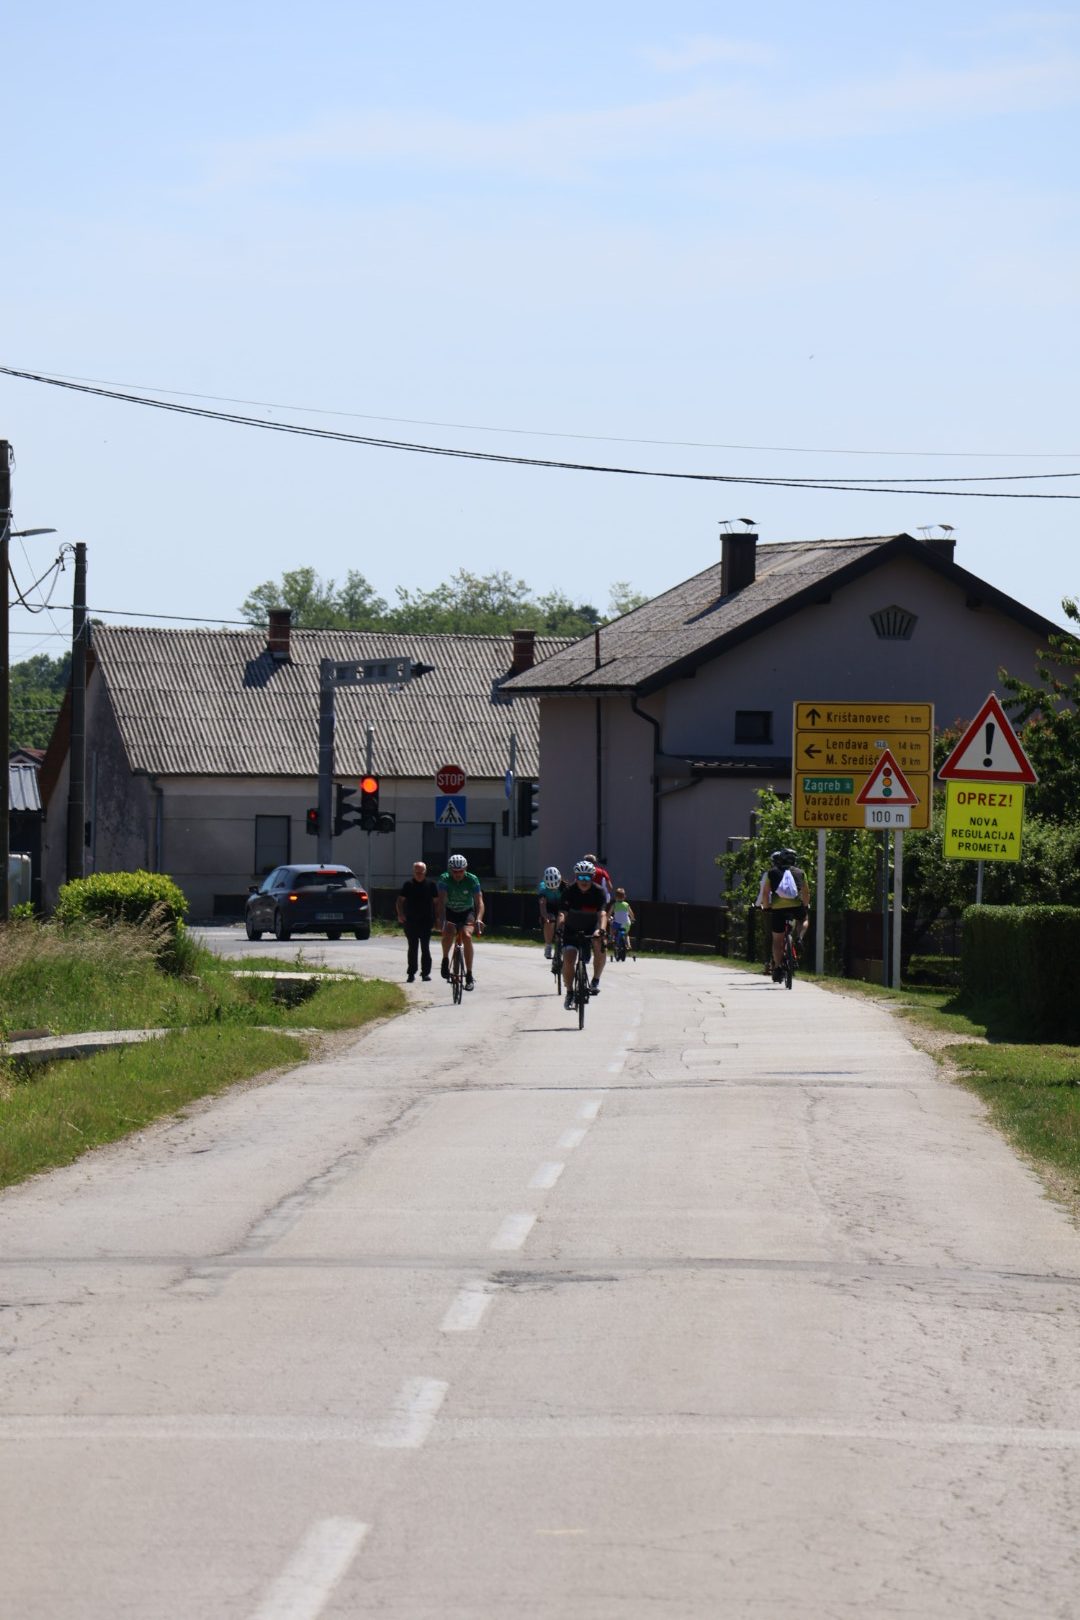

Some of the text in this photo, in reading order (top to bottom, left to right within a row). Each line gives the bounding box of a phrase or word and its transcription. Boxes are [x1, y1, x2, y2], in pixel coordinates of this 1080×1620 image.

[910, 715, 922, 723] km
[826, 738, 869, 750] Lendava
[898, 741, 907, 749] 14
[909, 741, 921, 750] km
[825, 754, 838, 765] M.
[909, 757, 921, 766] km
[436, 772, 465, 786] STOP
[804, 779, 841, 793] Zagreb
[804, 794, 850, 806] Varaždin
[957, 791, 1013, 807] OPREZ!
[803, 808, 848, 822] Čakovec
[872, 811, 905, 823] 100 m
[969, 817, 998, 827] NOVA
[951, 829, 1015, 840] REGULACIJA
[958, 842, 1007, 853] PROMETA
